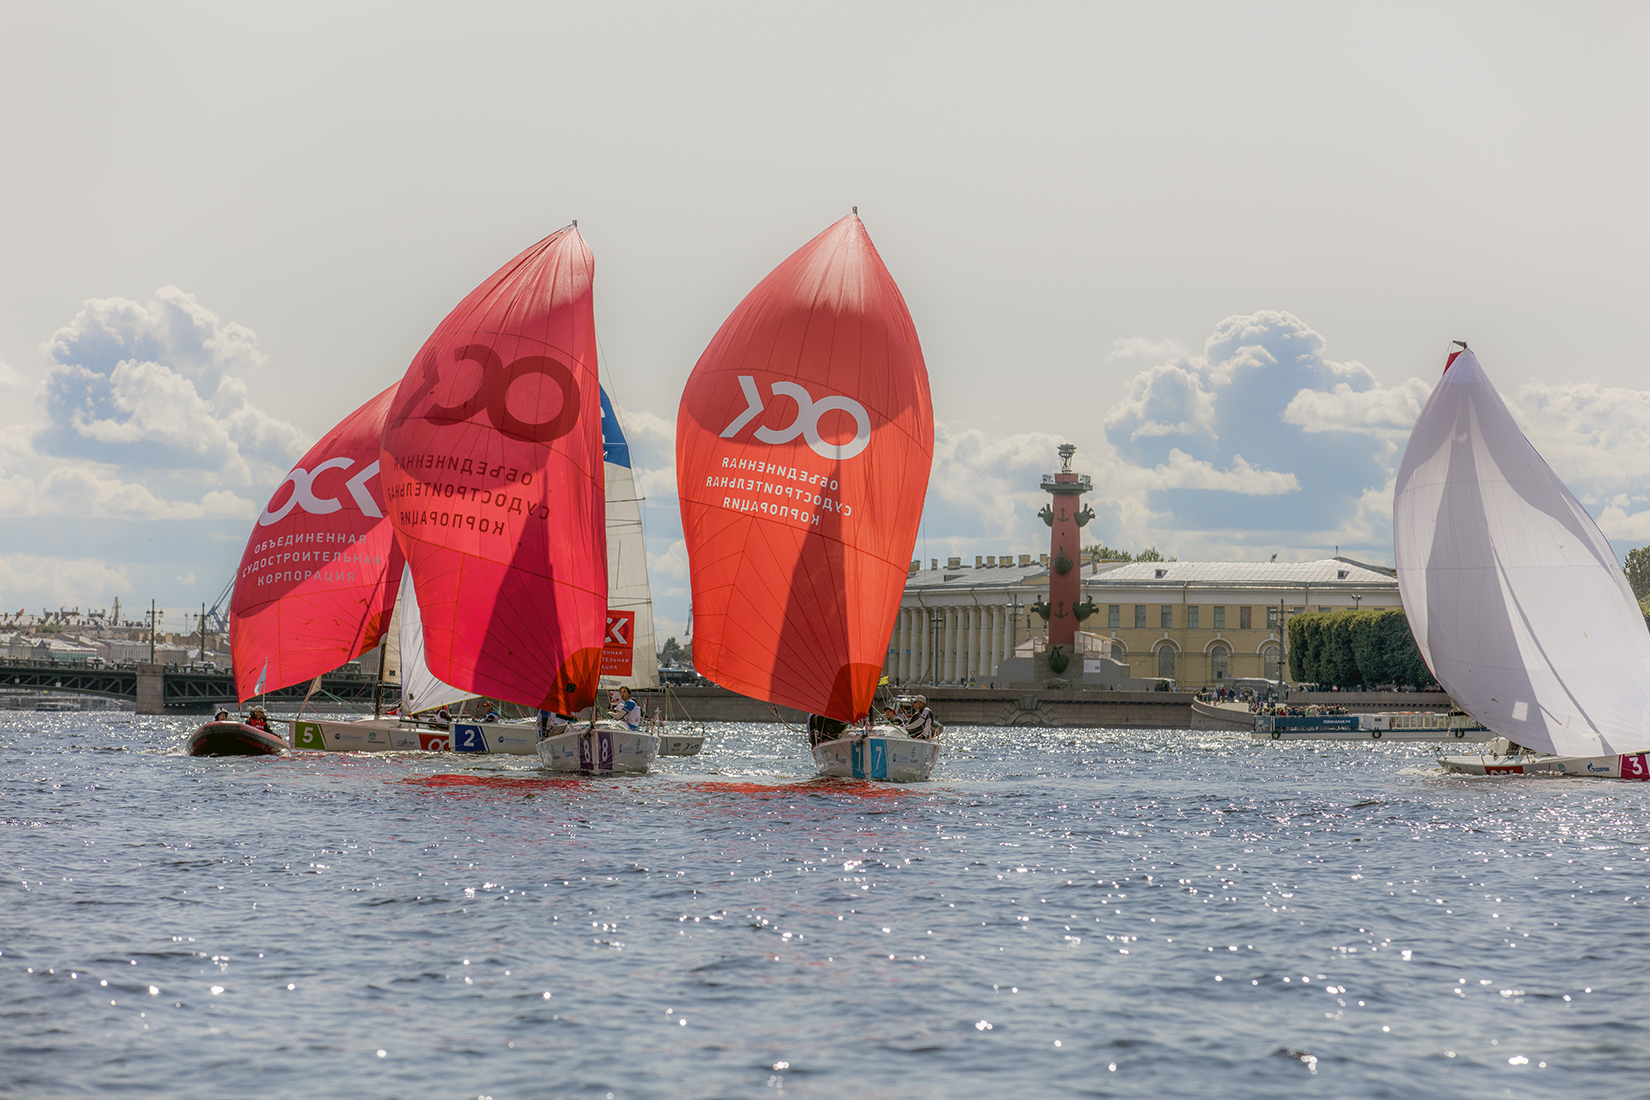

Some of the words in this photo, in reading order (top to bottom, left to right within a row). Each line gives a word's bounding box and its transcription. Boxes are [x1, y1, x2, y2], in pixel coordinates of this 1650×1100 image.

[254, 532, 367, 554] ОБЪЕДИНЕННАЯ
[242, 551, 381, 578] СУДОСТРОИТЕЛЬНАЯ
[257, 570, 355, 586] КОРПОРАЦИЯ
[302, 727, 314, 743] 5
[463, 729, 475, 747] 2
[583, 739, 591, 763] 8
[601, 738, 608, 762] 8
[875, 746, 883, 770] 7
[1628, 756, 1643, 775] 3
